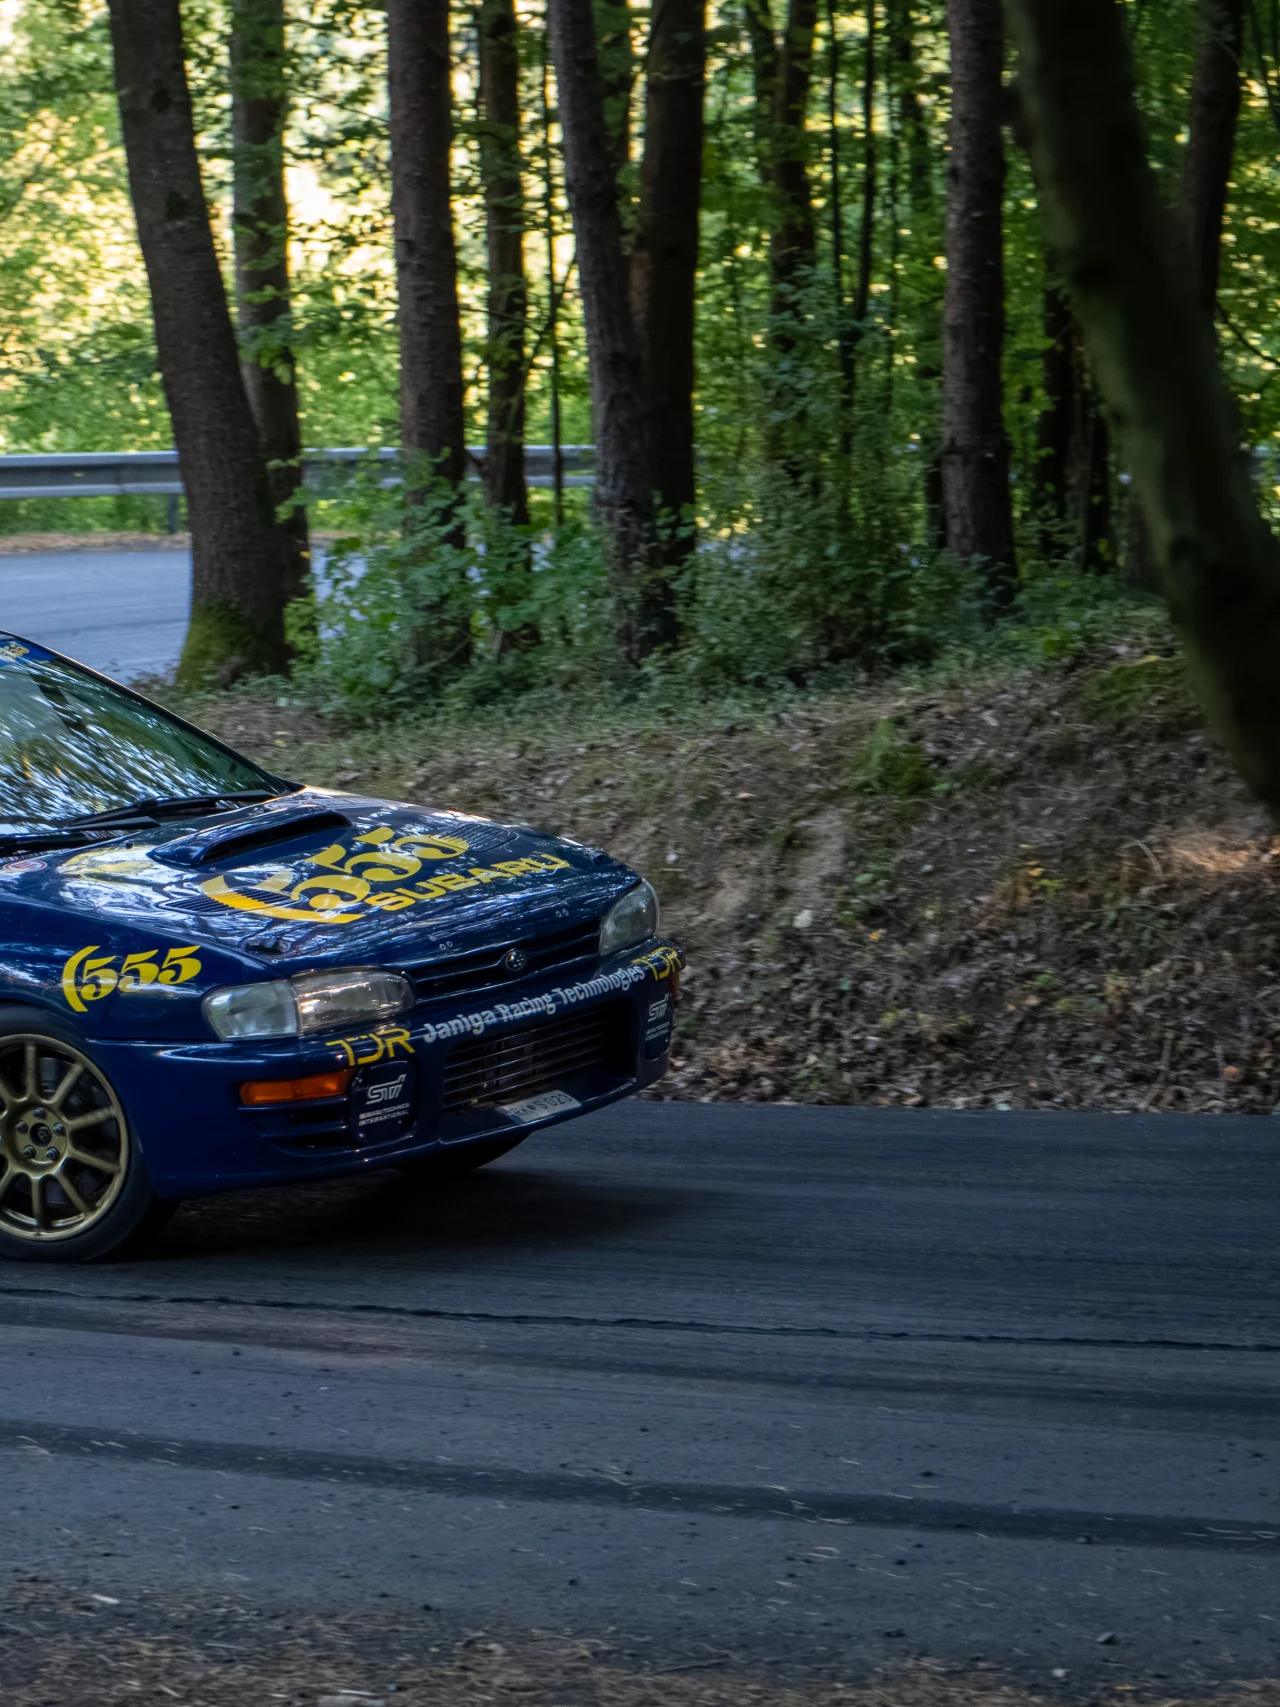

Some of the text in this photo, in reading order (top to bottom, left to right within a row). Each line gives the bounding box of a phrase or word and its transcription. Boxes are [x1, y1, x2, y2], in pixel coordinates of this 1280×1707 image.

[365, 853, 571, 912] SUBARU
[422, 1008, 498, 1044] Janiga
[498, 990, 558, 1024] Racing
[553, 963, 646, 1005] Technologies
